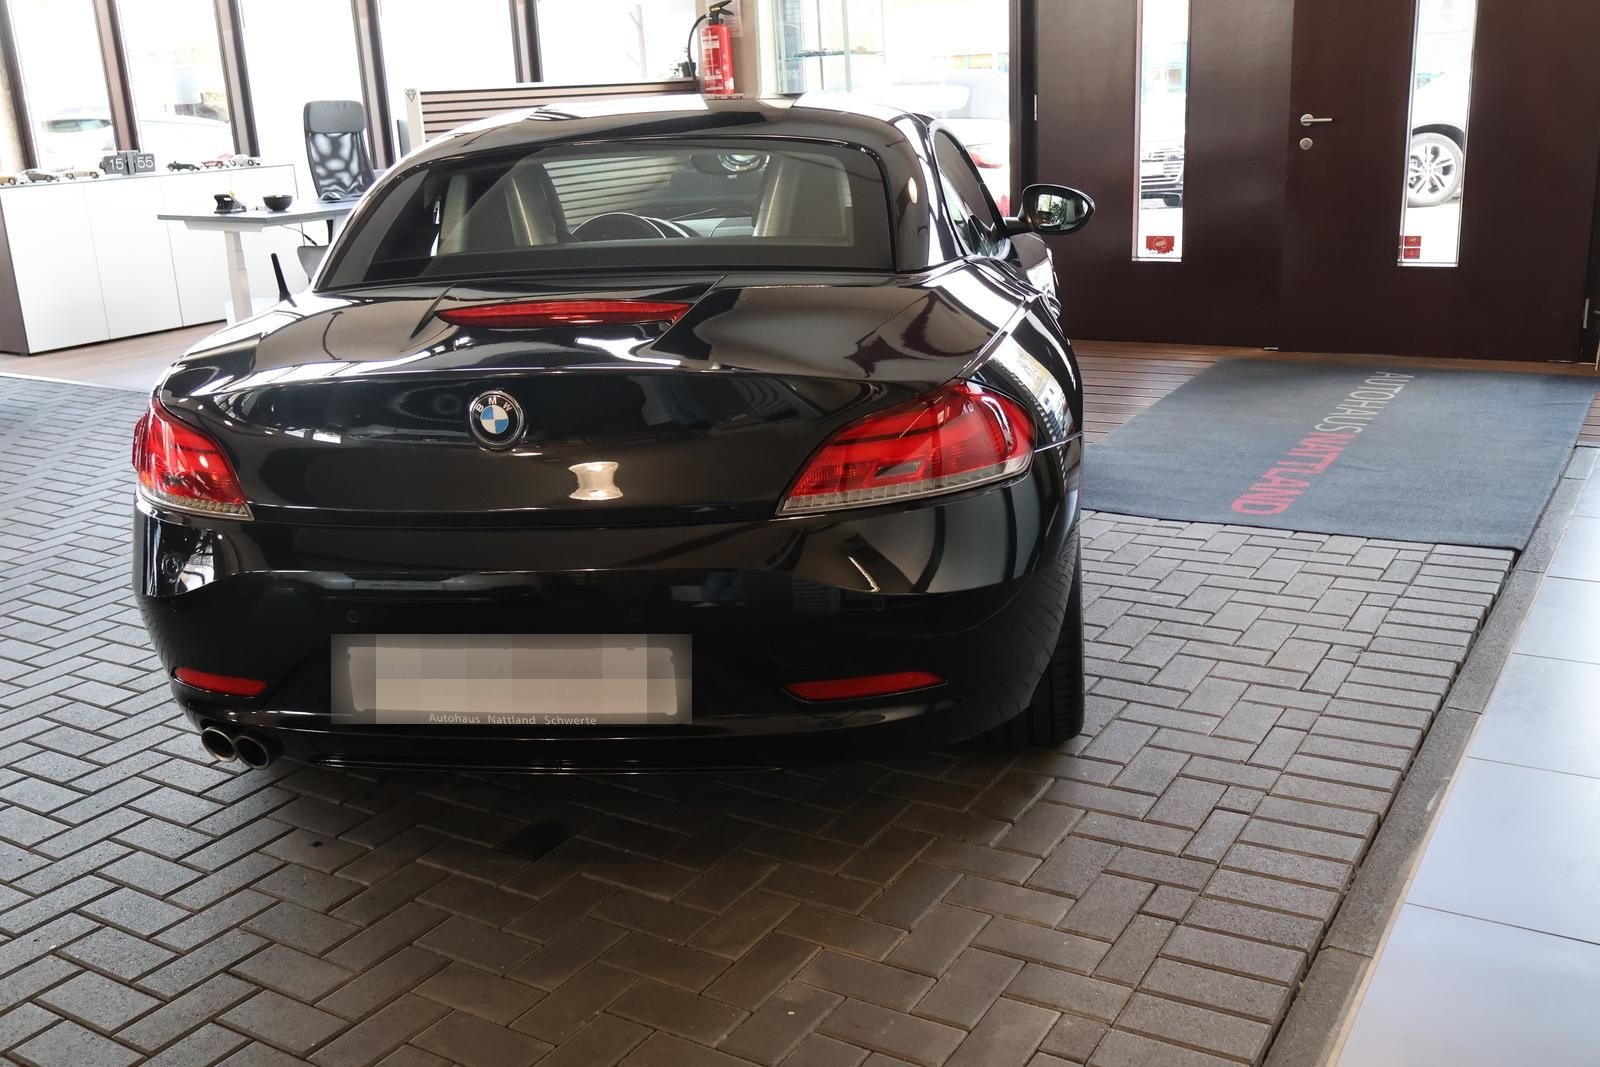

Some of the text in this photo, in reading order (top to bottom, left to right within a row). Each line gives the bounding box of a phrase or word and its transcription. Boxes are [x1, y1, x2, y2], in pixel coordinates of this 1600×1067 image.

[109, 156, 154, 170] 15 55
[475, 396, 513, 413] BMW
[1314, 371, 1415, 433] AUTOHAUS
[429, 713, 597, 725] Autohaus Nattland Schwerte
